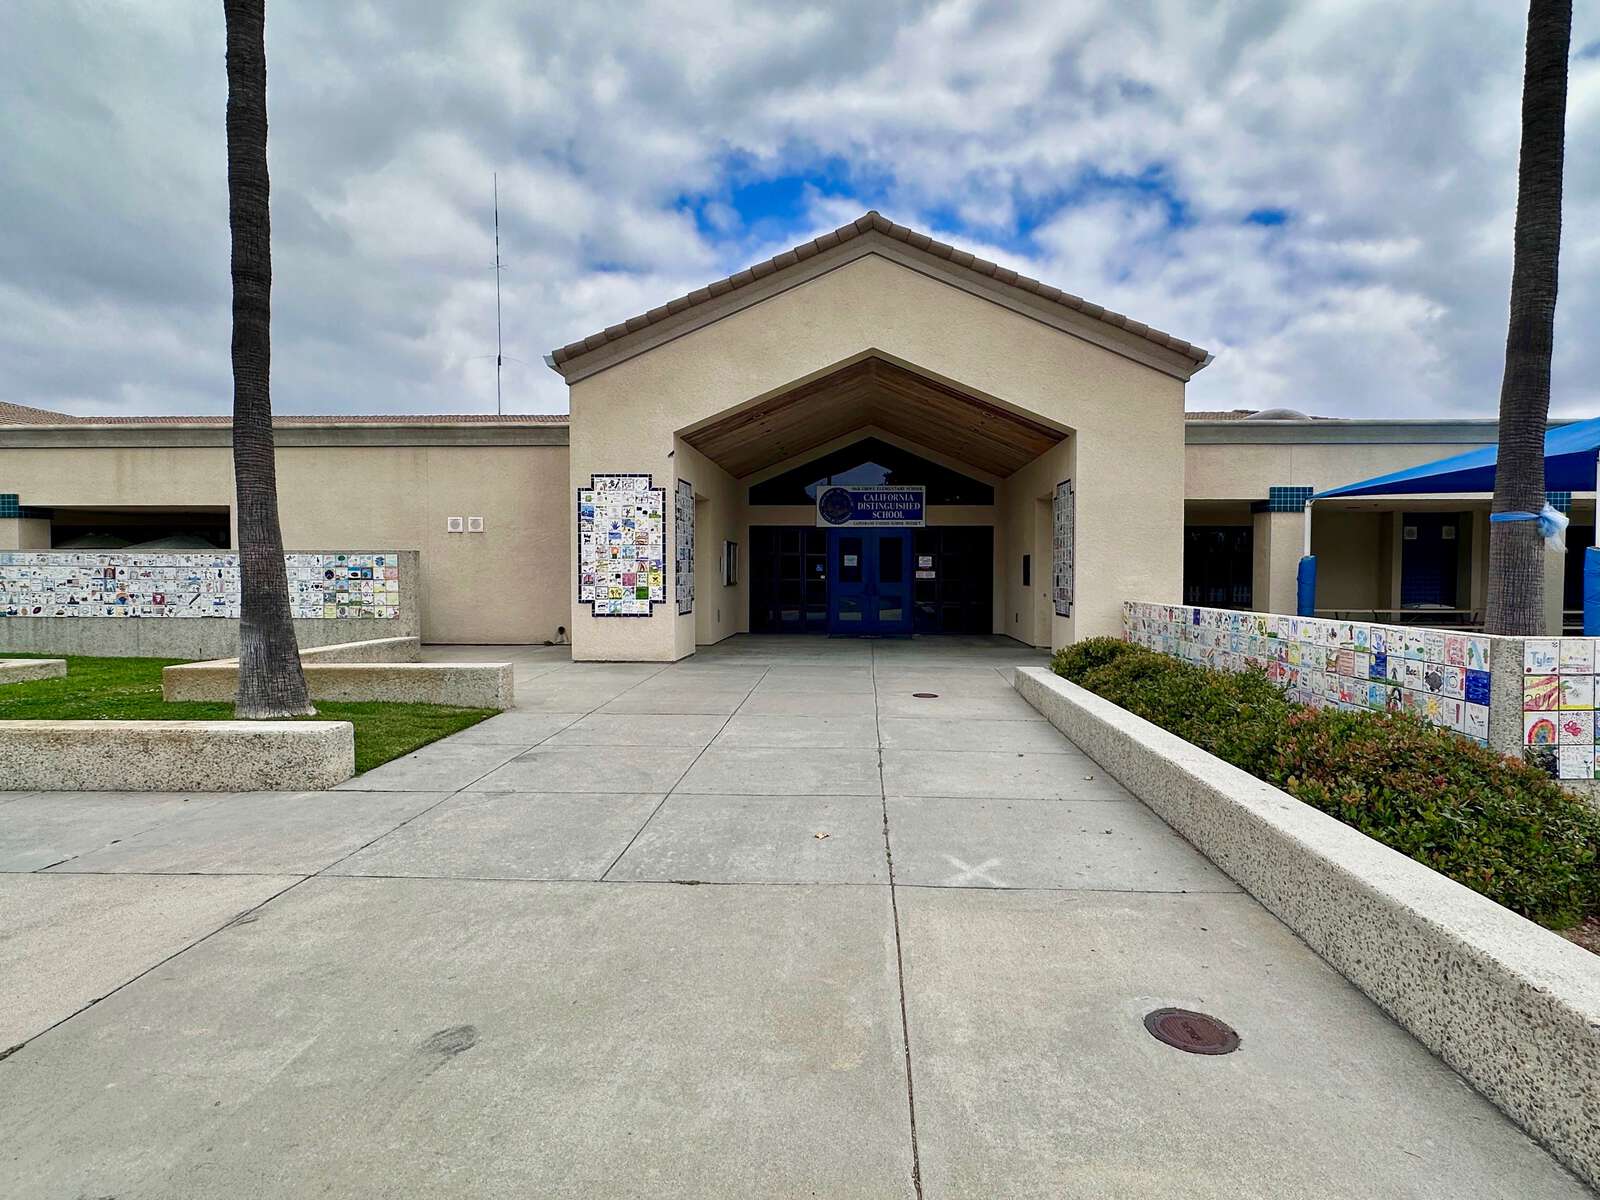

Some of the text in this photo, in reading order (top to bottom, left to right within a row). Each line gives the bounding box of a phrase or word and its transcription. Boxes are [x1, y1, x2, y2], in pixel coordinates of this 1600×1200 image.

[863, 493, 914, 502] CALIFORNIA
[857, 502, 921, 510] DISTINGUISHED
[872, 511, 905, 519] SCHOOL
[1530, 651, 1555, 667] Tyler
